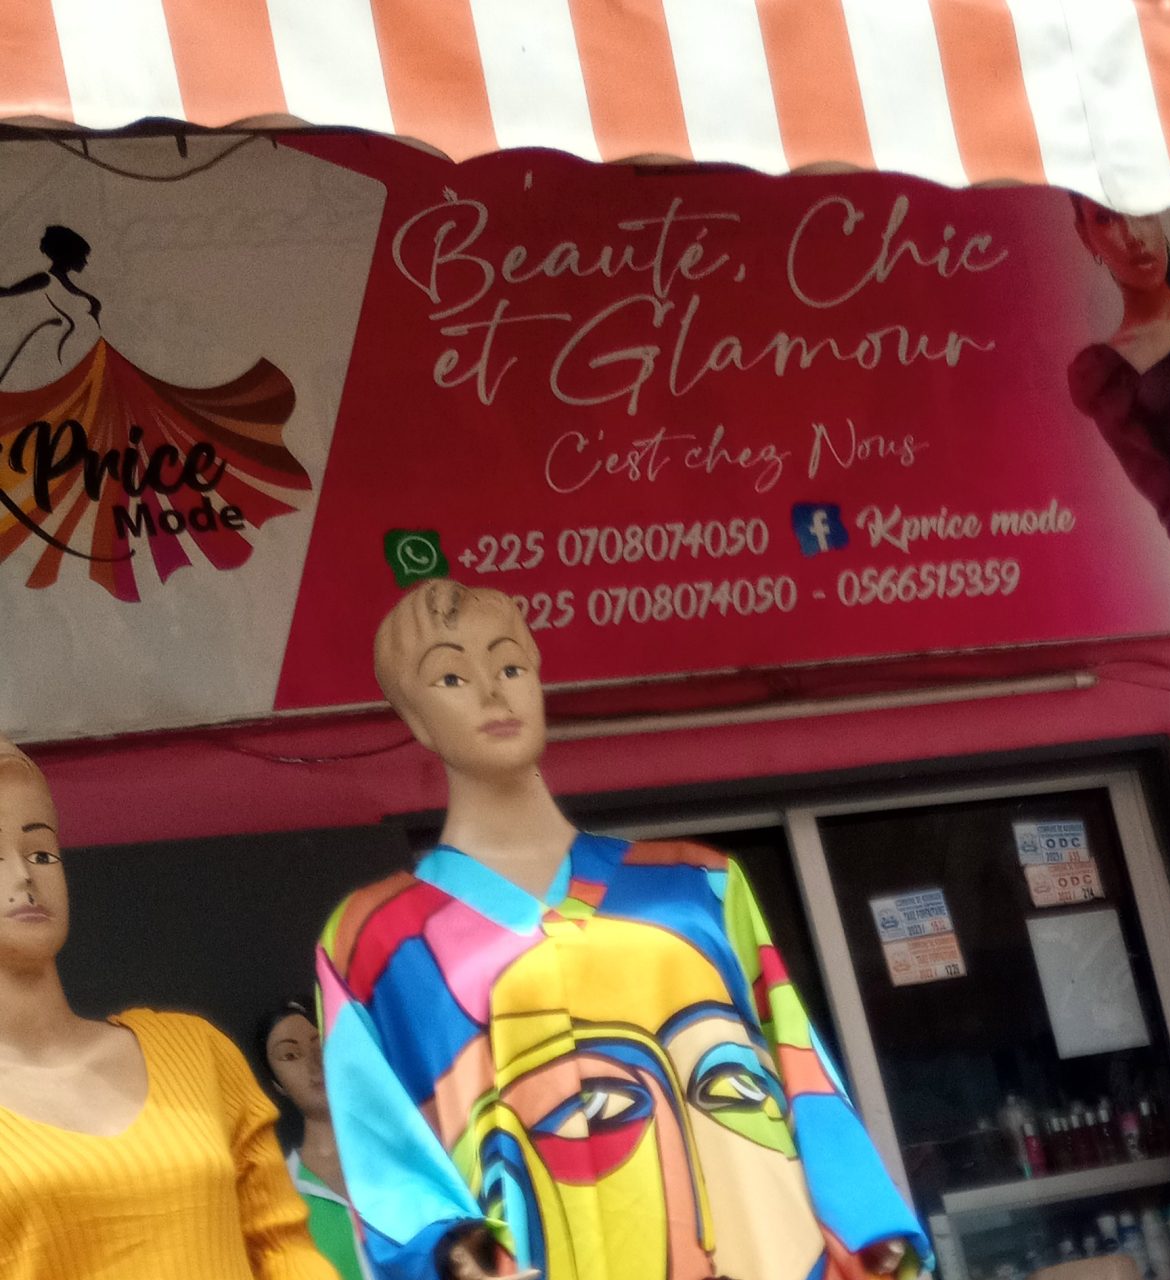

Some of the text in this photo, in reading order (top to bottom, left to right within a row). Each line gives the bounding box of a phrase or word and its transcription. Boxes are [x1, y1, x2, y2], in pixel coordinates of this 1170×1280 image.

[392, 194, 1009, 321] Beauté, Chic
[434, 294, 997, 416] et Glamour
[684, 424, 792, 493] chez
[807, 418, 930, 480] Nous
[112, 495, 246, 540] Mode
[457, 518, 770, 575] +225 0708074050
[856, 502, 982, 554] Kprice
[990, 498, 1076, 537] mode
[587, 575, 798, 626] 0708074050
[837, 560, 1021, 607] 0566515359
